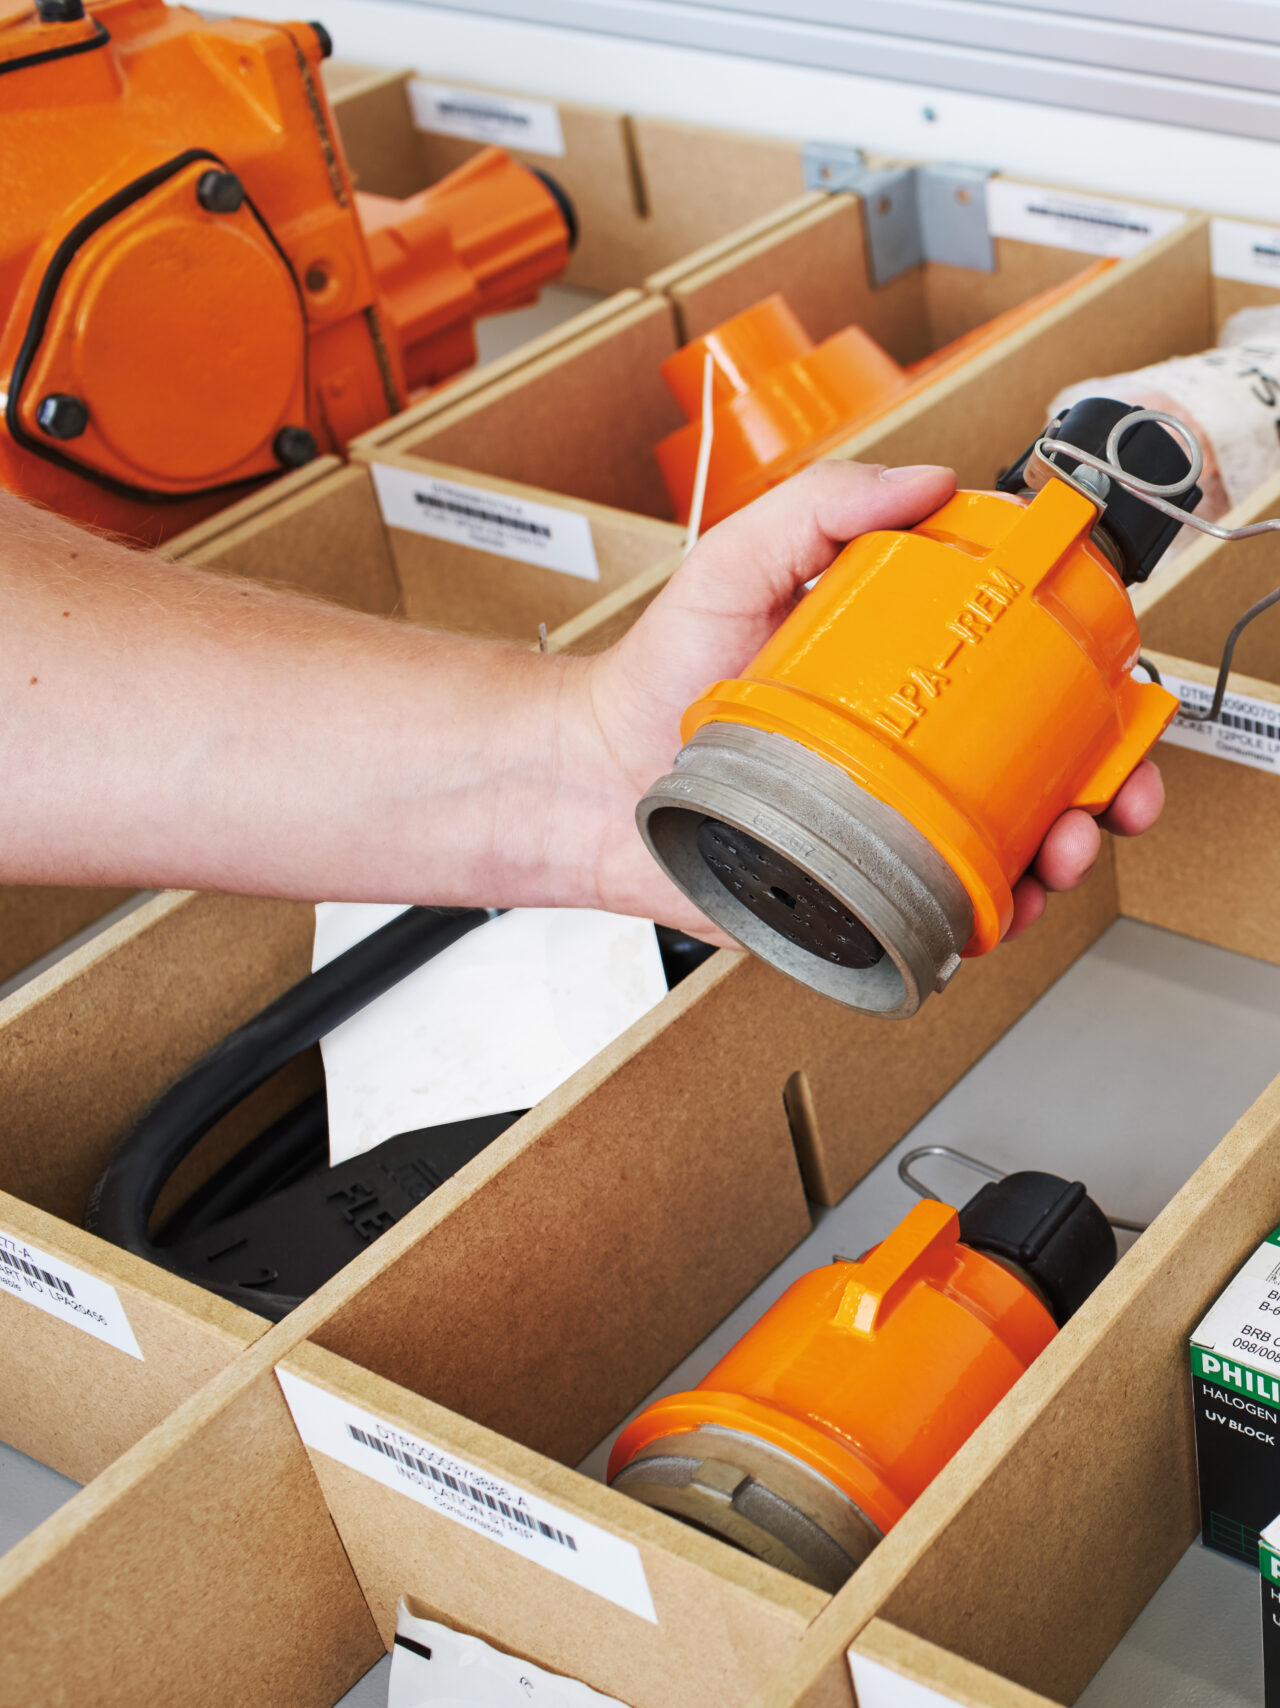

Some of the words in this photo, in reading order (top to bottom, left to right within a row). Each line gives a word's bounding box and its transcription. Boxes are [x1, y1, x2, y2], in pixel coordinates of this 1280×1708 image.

[1240, 1324, 1272, 1344] BRB
[1202, 1384, 1277, 1424] HALOGEN
[1205, 1408, 1226, 1425] UV
[1229, 1418, 1276, 1446] BLOCK
[396, 1464, 484, 1517] INSULATION
[487, 1511, 533, 1539] STRIP
[434, 1496, 504, 1538] Consumable
